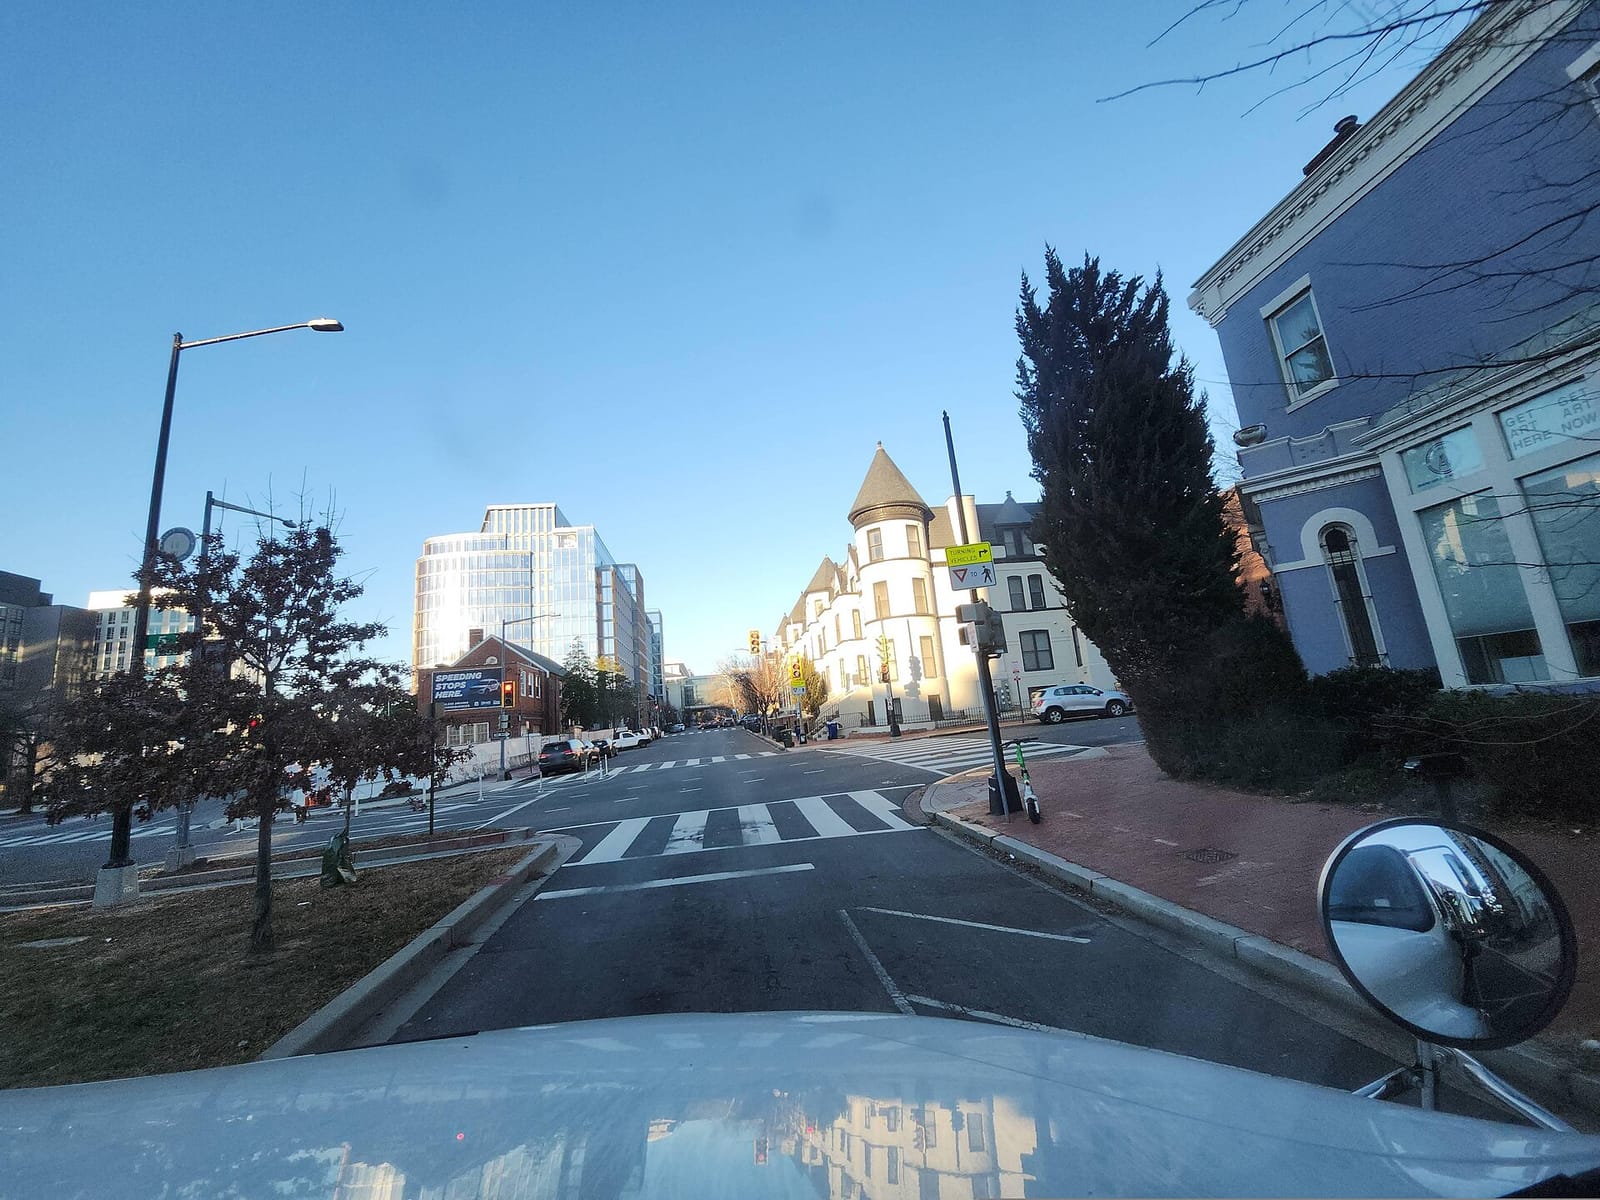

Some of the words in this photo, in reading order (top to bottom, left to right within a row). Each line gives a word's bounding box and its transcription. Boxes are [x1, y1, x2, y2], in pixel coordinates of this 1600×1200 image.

[1559, 388, 1586, 406] GET
[1506, 409, 1533, 427] GET
[1563, 400, 1592, 418] ART
[1510, 420, 1537, 439] ART
[1561, 412, 1597, 432] NOW
[1513, 429, 1552, 450] HERE
[950, 547, 975, 556] TURNING
[435, 672, 482, 682] SPEEDING
[435, 681, 467, 690] STOPS
[434, 690, 463, 699] HERE.
